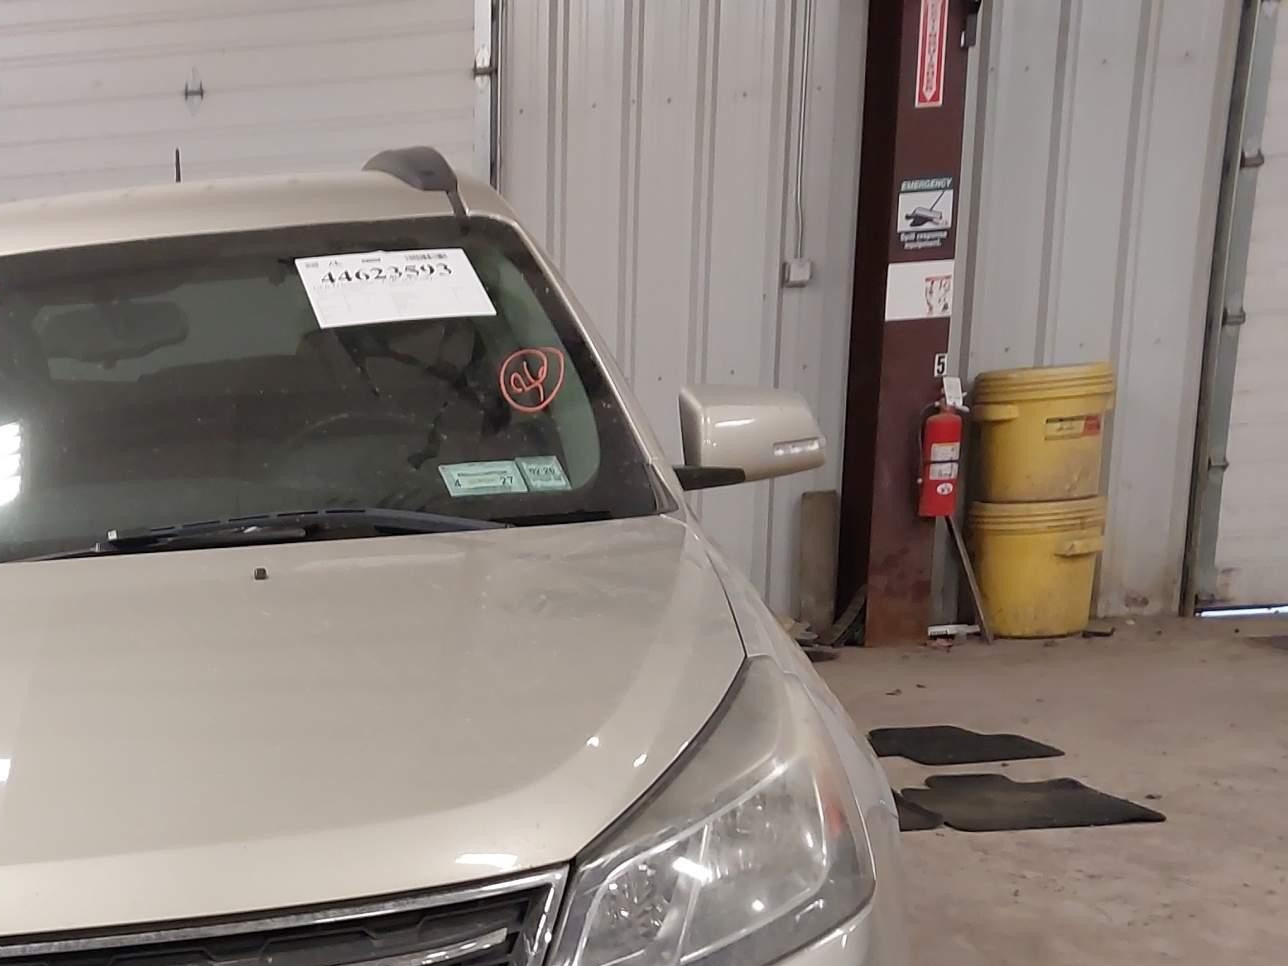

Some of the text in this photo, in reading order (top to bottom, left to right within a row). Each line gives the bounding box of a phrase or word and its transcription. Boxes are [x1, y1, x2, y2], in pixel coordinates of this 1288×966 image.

[900, 177, 953, 192] EMERGENCY
[320, 262, 453, 285] 44623593
[936, 355, 946, 374] 5
